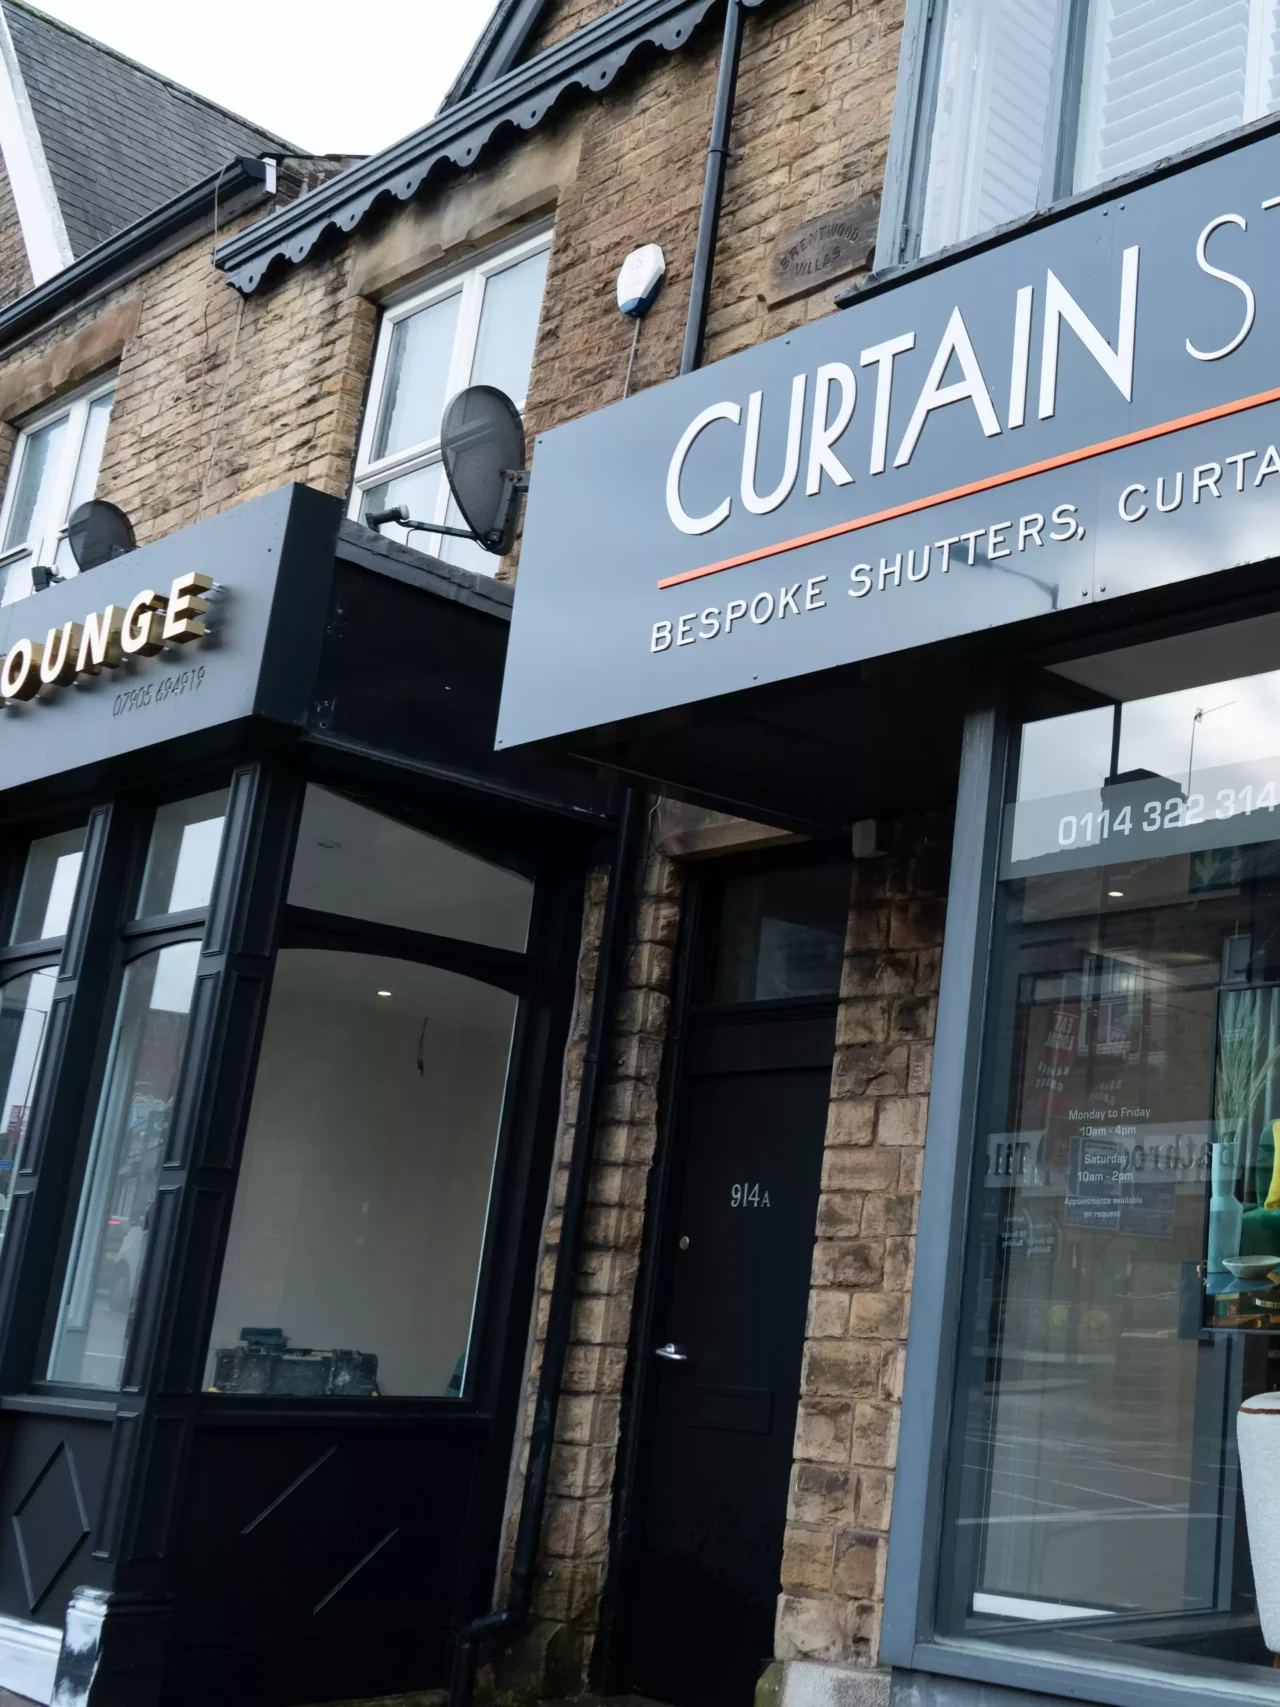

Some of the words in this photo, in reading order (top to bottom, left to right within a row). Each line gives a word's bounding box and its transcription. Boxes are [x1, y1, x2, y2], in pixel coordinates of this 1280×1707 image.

[780, 222, 860, 270] BRENTWOOD
[795, 246, 842, 277] VILLAS
[666, 245, 1140, 535] CURTAIN
[649, 575, 828, 653] BESPOKE
[847, 503, 1086, 599] SHUTTERS,
[0, 572, 210, 703] OUNGE
[112, 684, 154, 717] 07905
[1058, 805, 1132, 845] 0114
[1142, 797, 1204, 832] 322
[1068, 1109, 1106, 1121] Monday
[1108, 1109, 1118, 1119] to
[1120, 1106, 1151, 1119] Friday
[1080, 1125, 1107, 1137] 10am
[1114, 1124, 1137, 1138] 4pm
[1084, 1153, 1128, 1166] Saturday
[1077, 1171, 1104, 1182] 10am
[1112, 1170, 1134, 1183] 2pm
[731, 1183, 770, 1208] 914A
[1064, 1196, 1110, 1207] Appointments
[1112, 1194, 1143, 1205] available
[1094, 1209, 1121, 1219] request
